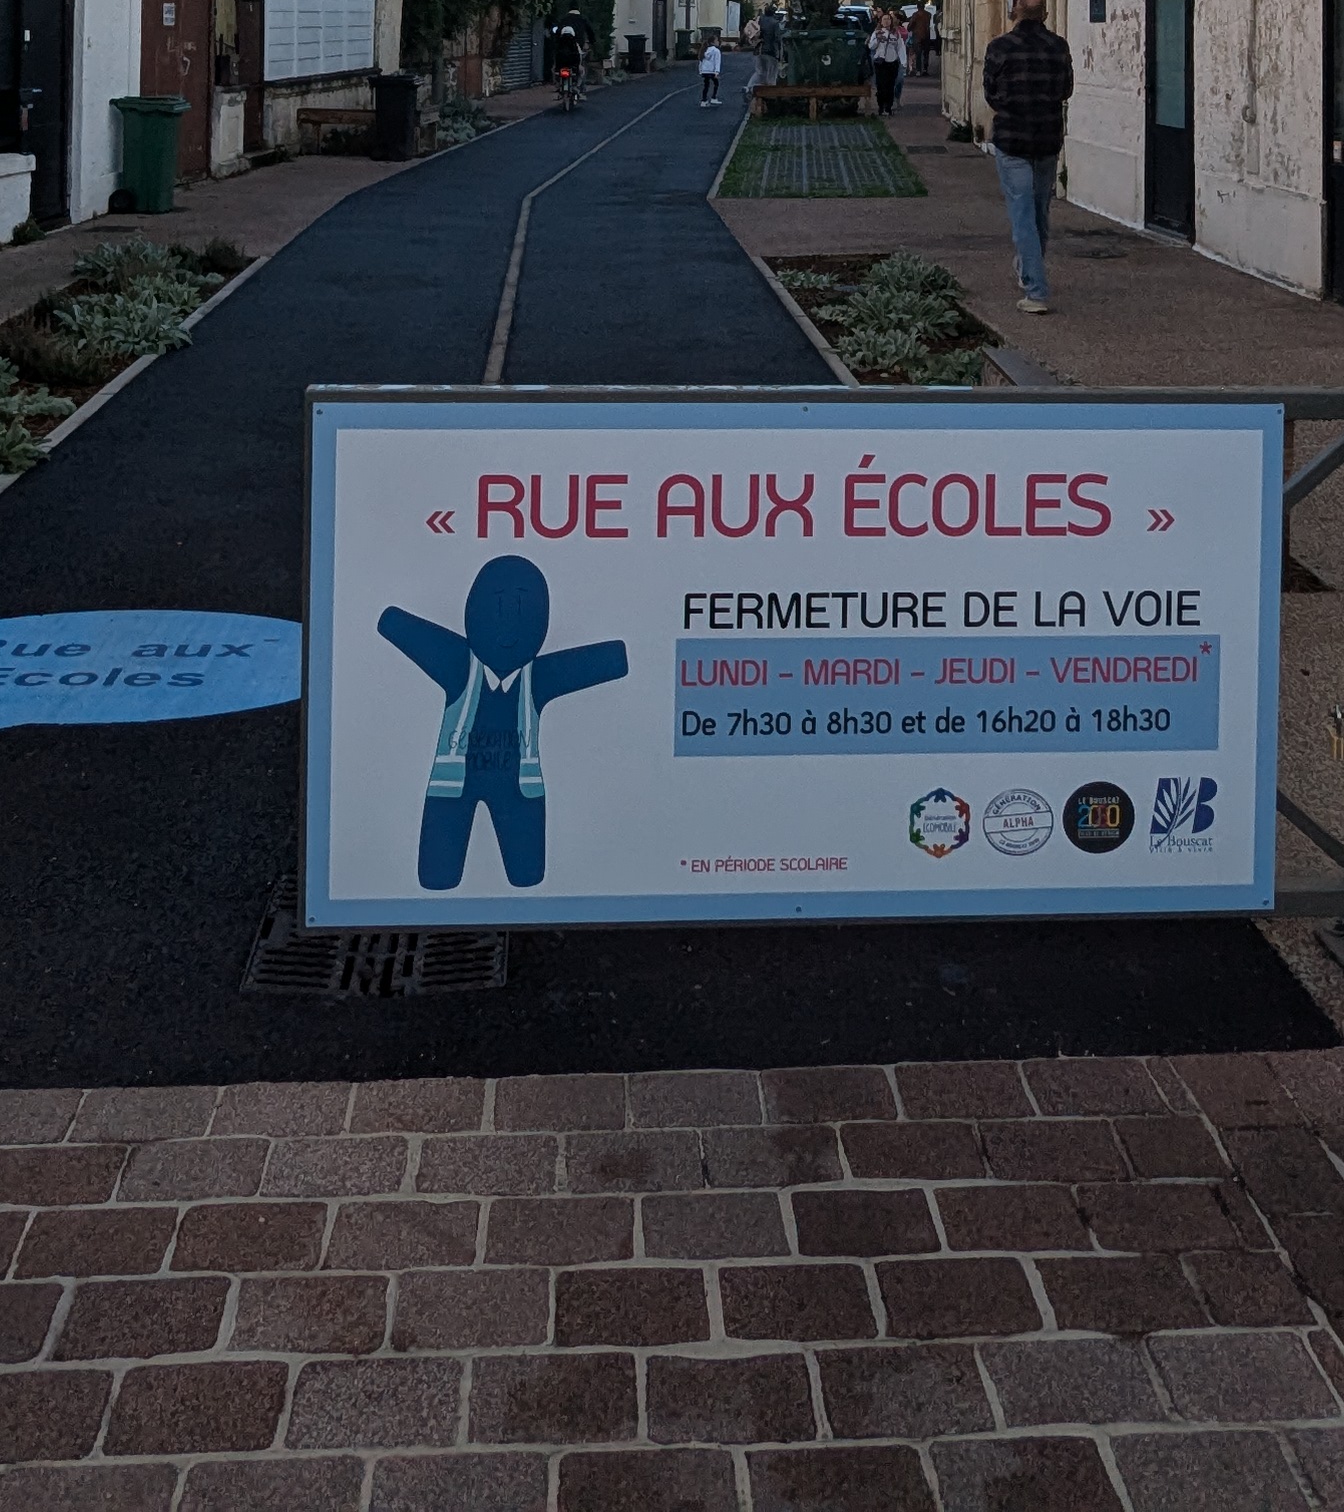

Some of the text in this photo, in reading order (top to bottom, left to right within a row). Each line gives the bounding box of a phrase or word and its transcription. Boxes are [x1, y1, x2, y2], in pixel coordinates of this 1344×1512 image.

[476, 473, 630, 539] RUE
[655, 472, 815, 538] AUX
[843, 454, 1113, 538] ÉCOLES
[683, 589, 1202, 630] FERMETURE DE LA VOIE
[132, 640, 255, 659] aux
[679, 659, 769, 688] LUNDI
[803, 658, 901, 687] MARDI
[933, 657, 1017, 686] JEUDI
[681, 707, 1171, 738] De 7h30 à 8h30 et de 16h20 à 18h30
[1003, 816, 1034, 829] ALPHA
[1167, 835, 1214, 847] Bouscat
[691, 855, 849, 874] EN PÉRIODE SCOLAIRE
